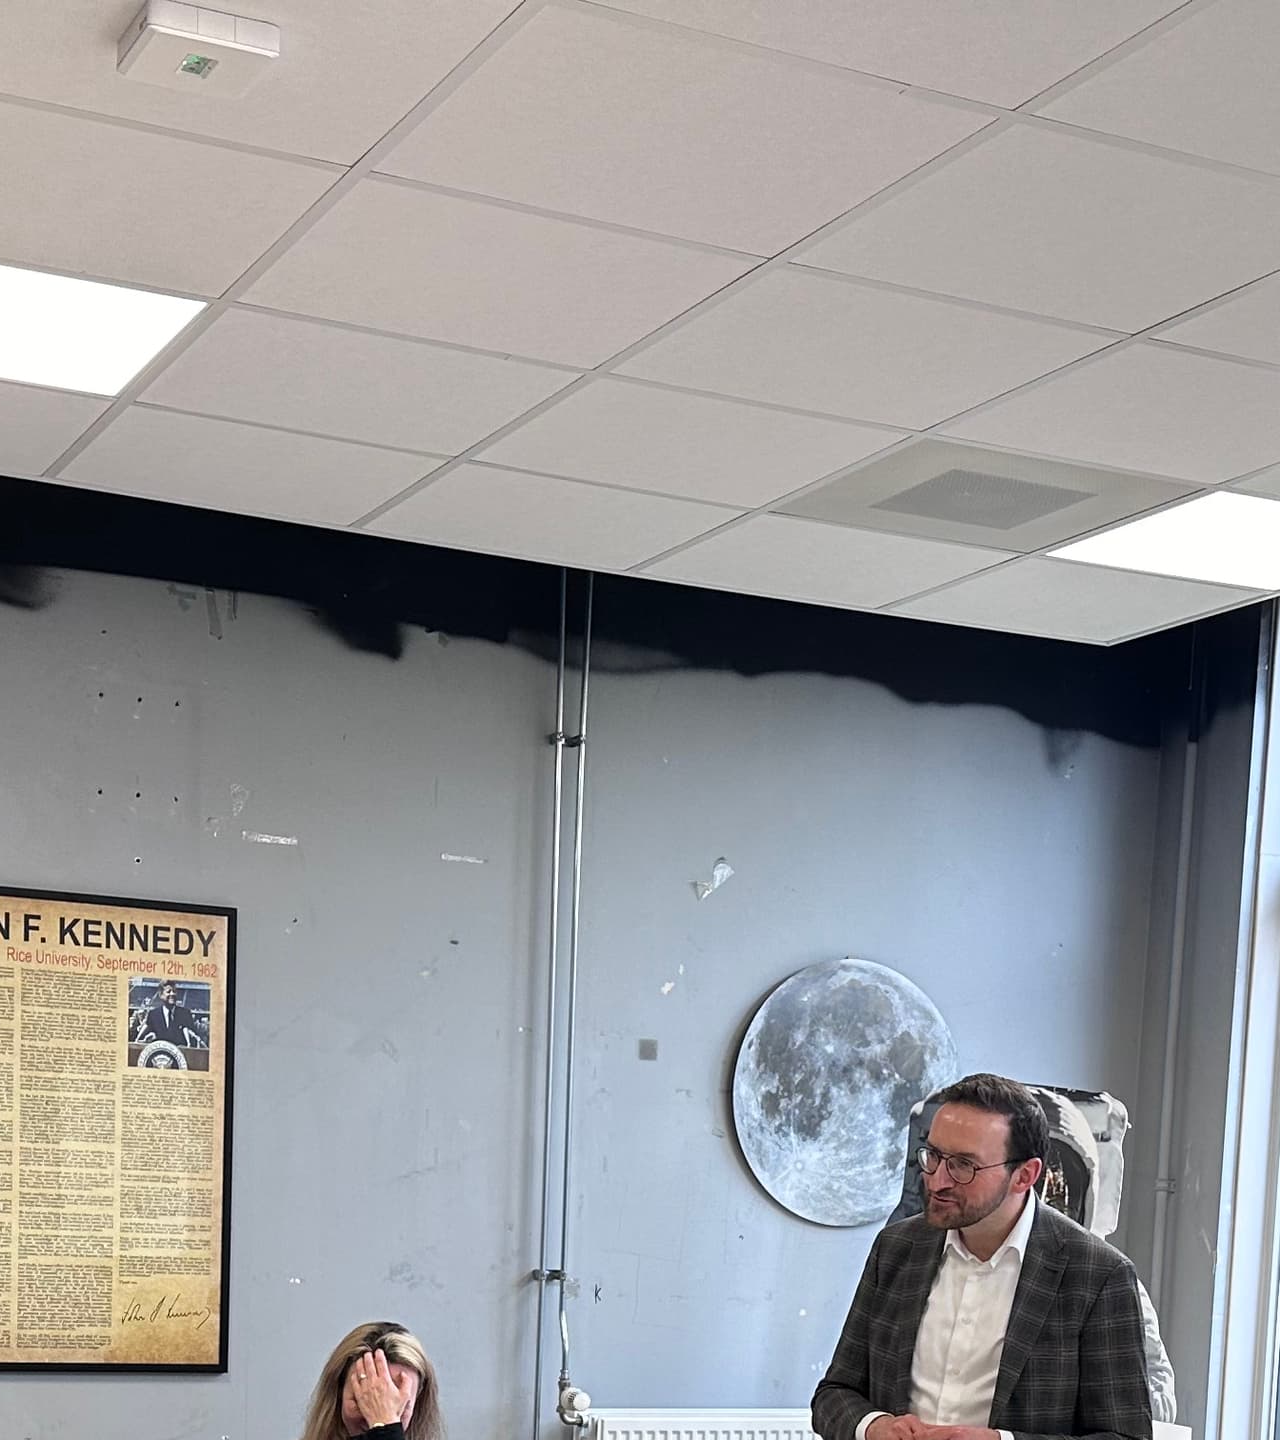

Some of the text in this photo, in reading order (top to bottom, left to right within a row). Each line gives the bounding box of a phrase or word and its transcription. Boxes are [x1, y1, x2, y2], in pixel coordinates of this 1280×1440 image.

[24, 914, 46, 943] F.
[59, 917, 217, 957] KENNEDY
[7, 946, 32, 963] Rice
[97, 954, 158, 973] September
[162, 960, 188, 977] 12th,
[192, 963, 218, 978] 1962
